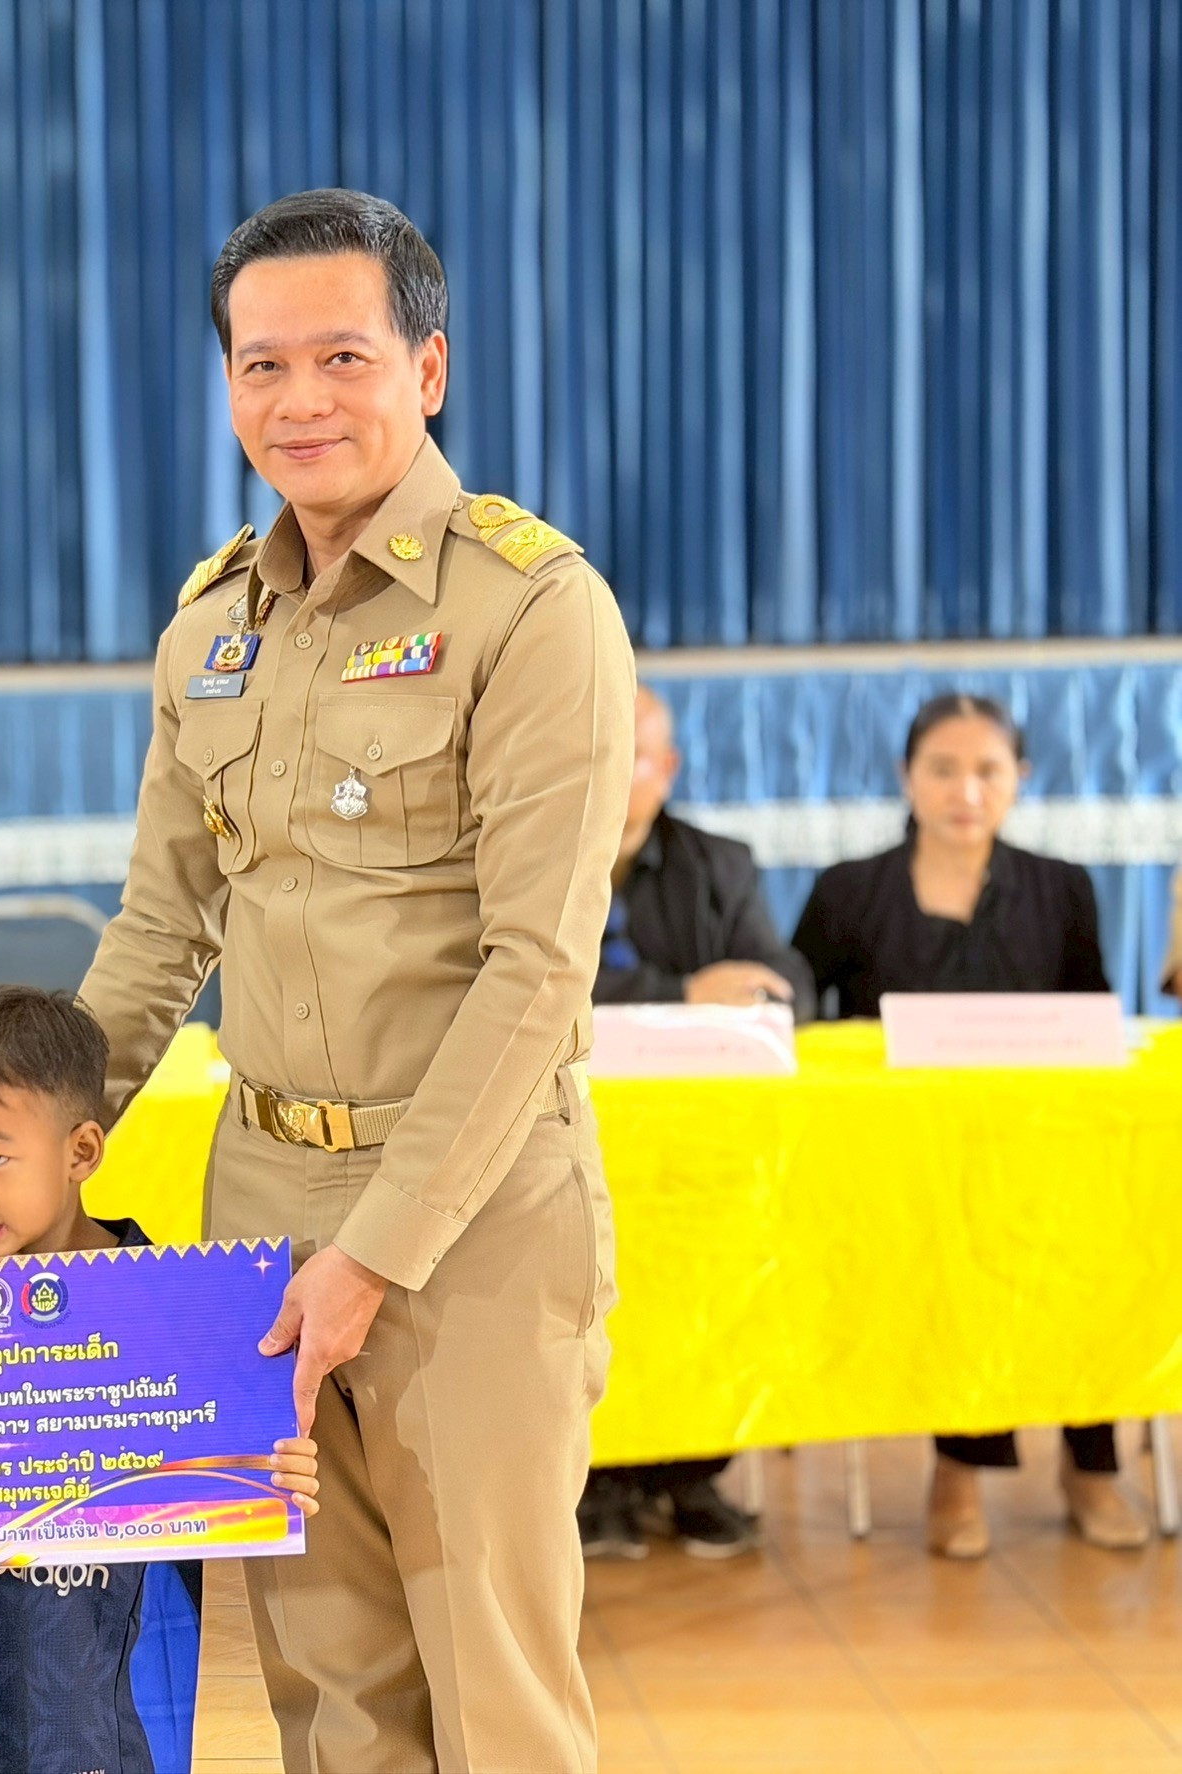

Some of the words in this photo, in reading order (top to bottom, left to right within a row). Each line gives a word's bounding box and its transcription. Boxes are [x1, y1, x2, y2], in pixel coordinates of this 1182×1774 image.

[36, 1400, 217, 1433] สยามบรมราชกุมารี
[19, 1450, 95, 1475] ประจำปี
[100, 1450, 164, 1471] ๒๕๖๙
[37, 1519, 98, 1540] เป็นเงิน
[104, 1522, 163, 1539] ๒,๐๐๐
[169, 1519, 207, 1534] บาท
